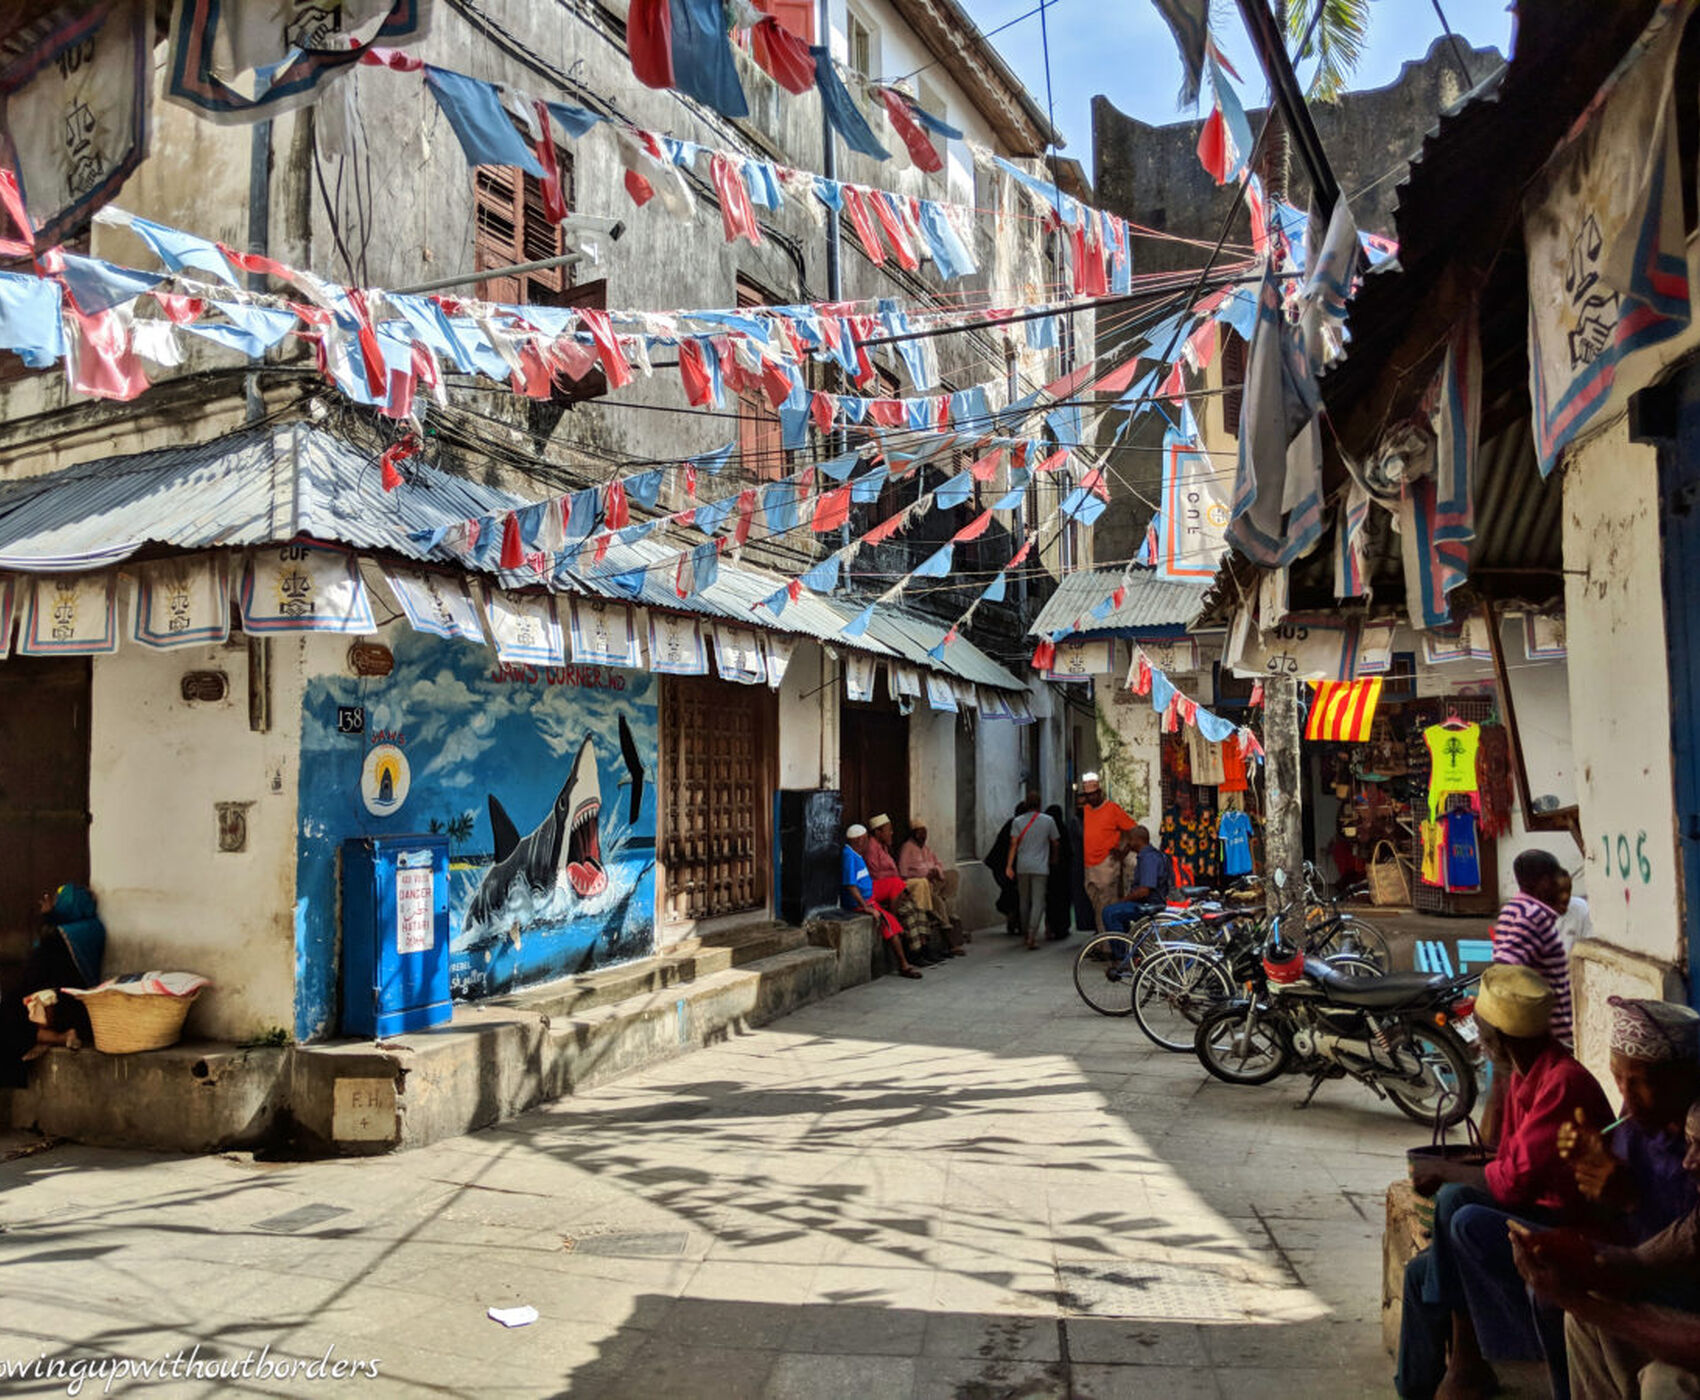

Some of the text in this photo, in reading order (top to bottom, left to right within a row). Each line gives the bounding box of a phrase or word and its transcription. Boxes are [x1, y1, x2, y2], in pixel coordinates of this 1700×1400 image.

[1186, 492, 1200, 535] CUF
[280, 547, 312, 561] CUF
[337, 707, 362, 732] 138
[1602, 829, 1651, 885] 106
